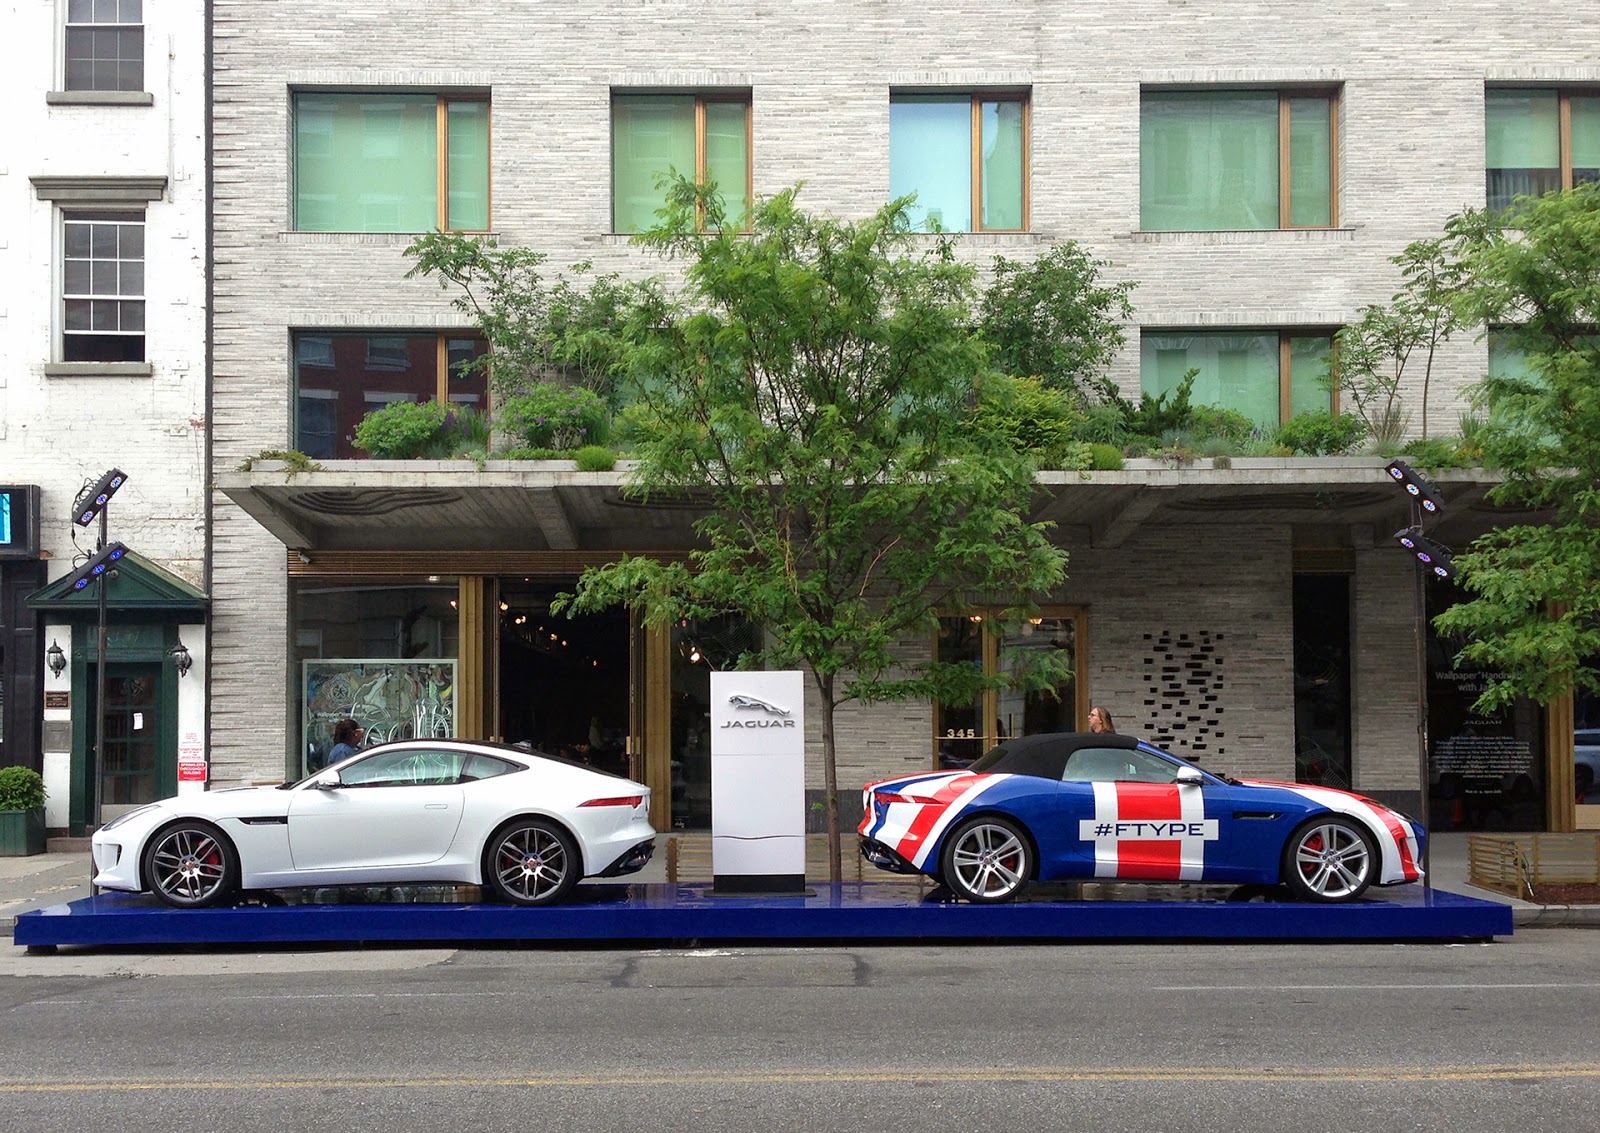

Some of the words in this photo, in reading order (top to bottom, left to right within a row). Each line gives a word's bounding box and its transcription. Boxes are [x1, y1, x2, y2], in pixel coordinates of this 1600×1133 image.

[1457, 683, 1477, 692] with
[721, 720, 795, 729] JAGUAR
[947, 729, 975, 739] 345
[1094, 823, 1204, 836] #FTYPE
